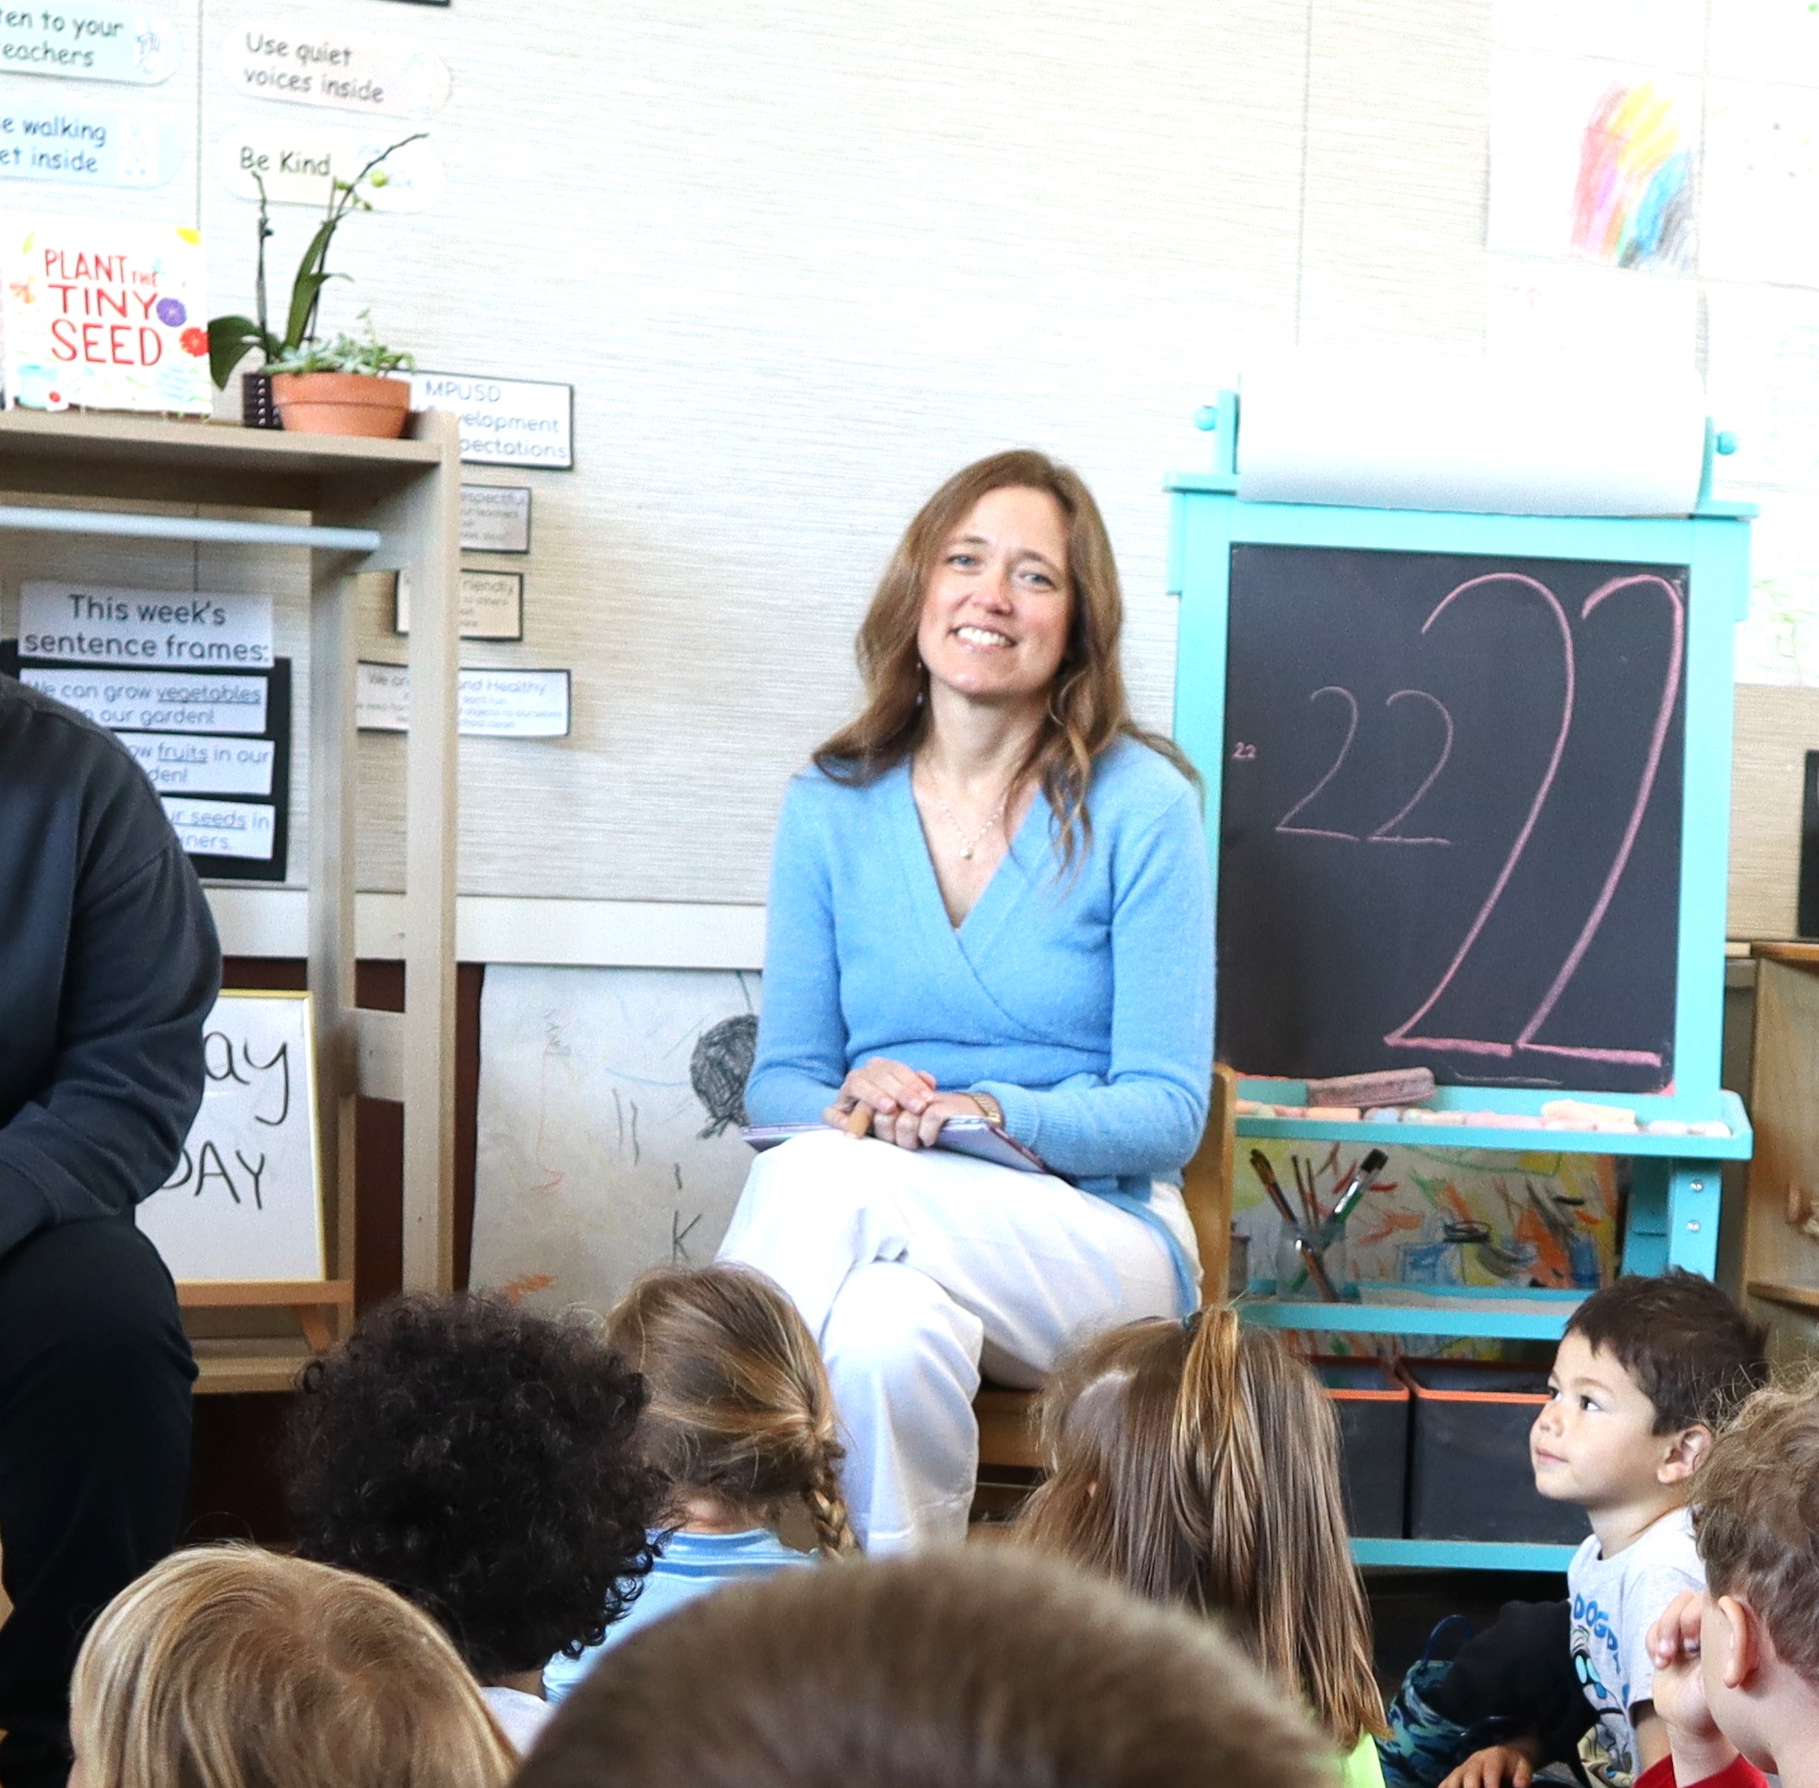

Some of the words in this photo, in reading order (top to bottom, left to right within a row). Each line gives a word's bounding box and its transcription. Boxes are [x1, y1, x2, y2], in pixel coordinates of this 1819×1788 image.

[40, 10, 68, 34] to
[73, 18, 124, 42] your
[246, 33, 289, 59] Use
[294, 41, 352, 69] quiet
[243, 64, 313, 92] voices
[320, 74, 384, 104] inside
[21, 115, 106, 147] walking
[31, 146, 98, 174] inside
[239, 148, 269, 172] Be
[280, 149, 330, 178] Kind
[44, 248, 128, 281] PLANT
[48, 285, 157, 317] TINY
[51, 321, 162, 367] SEED
[68, 593, 129, 622] This
[137, 600, 226, 626] week's
[25, 631, 156, 657] sentence
[165, 634, 270, 663] frames:
[61, 684, 98, 701] can
[103, 685, 153, 705] grow
[156, 686, 262, 705] vegetables
[101, 708, 134, 724] our
[156, 742, 209, 764] fruits
[213, 744, 232, 762] in
[236, 747, 269, 763] our
[1233, 742, 1257, 760] 22
[1276, 686, 1452, 845] 22
[190, 810, 247, 830] seeds
[252, 813, 270, 830] in
[1384, 571, 1684, 1067] 22
